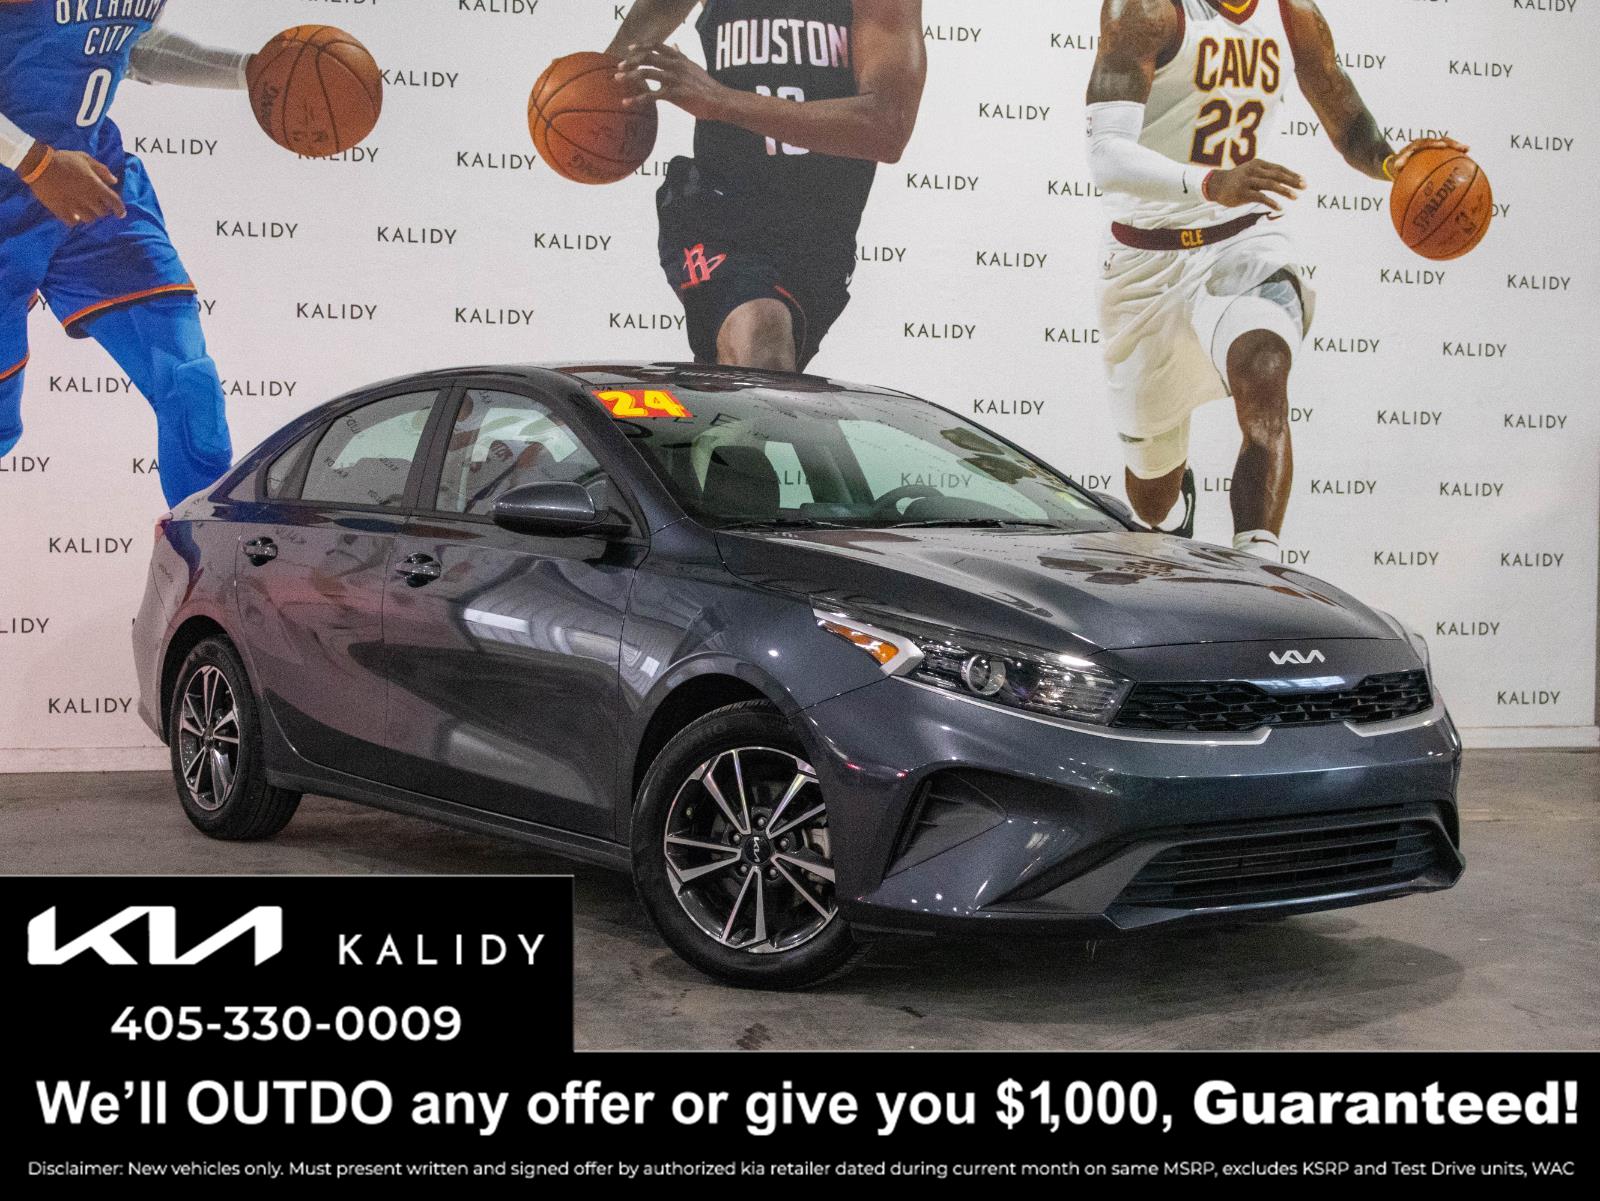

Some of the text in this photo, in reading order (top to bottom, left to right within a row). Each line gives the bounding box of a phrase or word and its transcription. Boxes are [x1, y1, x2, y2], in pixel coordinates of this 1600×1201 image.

[458, 0, 538, 15] KALIDY
[1513, 0, 1576, 12] KALIDY
[84, 25, 134, 55] CITY
[923, 25, 981, 42] ALIDY
[1050, 33, 1102, 50] KALI
[716, 18, 849, 71] HOUSTON
[1193, 36, 1280, 94] CAVS
[1334, 53, 1386, 70] ALIDY
[1450, 61, 1512, 77] KALIDY
[76, 68, 112, 127] 0
[980, 103, 1049, 120] KALIDY
[1190, 98, 1265, 168] 23
[135, 137, 217, 155] KALIDY
[1511, 135, 1573, 151] KALIDY
[457, 152, 535, 169] KALIDY
[907, 173, 978, 190] KALIDY
[1318, 195, 1383, 211] KALIDY
[217, 221, 297, 238] KALIDY
[378, 227, 456, 244] KALIDY
[535, 233, 611, 250] KALIDY
[1180, 229, 1204, 247] CLE
[854, 246, 906, 263] LIDY
[977, 252, 1047, 267] KALIDY
[1381, 269, 1445, 284] KALIDY
[1508, 275, 1570, 290] KALIDY
[297, 303, 376, 319] KALIDY
[456, 308, 533, 324] KALIDY
[609, 313, 685, 330] KALIDY
[905, 323, 975, 339] KALIDY
[1045, 327, 1100, 344] KALID
[1314, 338, 1379, 352] KALIDY
[1443, 342, 1506, 357] KALIDY
[50, 377, 132, 393] KALIDY
[598, 389, 687, 418] 24
[974, 400, 1044, 414] KALIDY
[1378, 411, 1441, 425] KALIDY
[1505, 414, 1567, 428] KALIDY
[0, 457, 50, 473] LIDY
[901, 473, 973, 489] KALIDY
[1312, 480, 1376, 494] KALIDY
[1440, 483, 1503, 496] KALIDY
[50, 538, 132, 553] KALIDY
[1375, 552, 1438, 565] KALIDY
[1501, 553, 1563, 566] KALIDY
[1437, 622, 1499, 635] KALIDY
[1268, 649, 1326, 665] KIA
[49, 698, 132, 713] KALIDY
[1498, 691, 1560, 704] KALIDY
